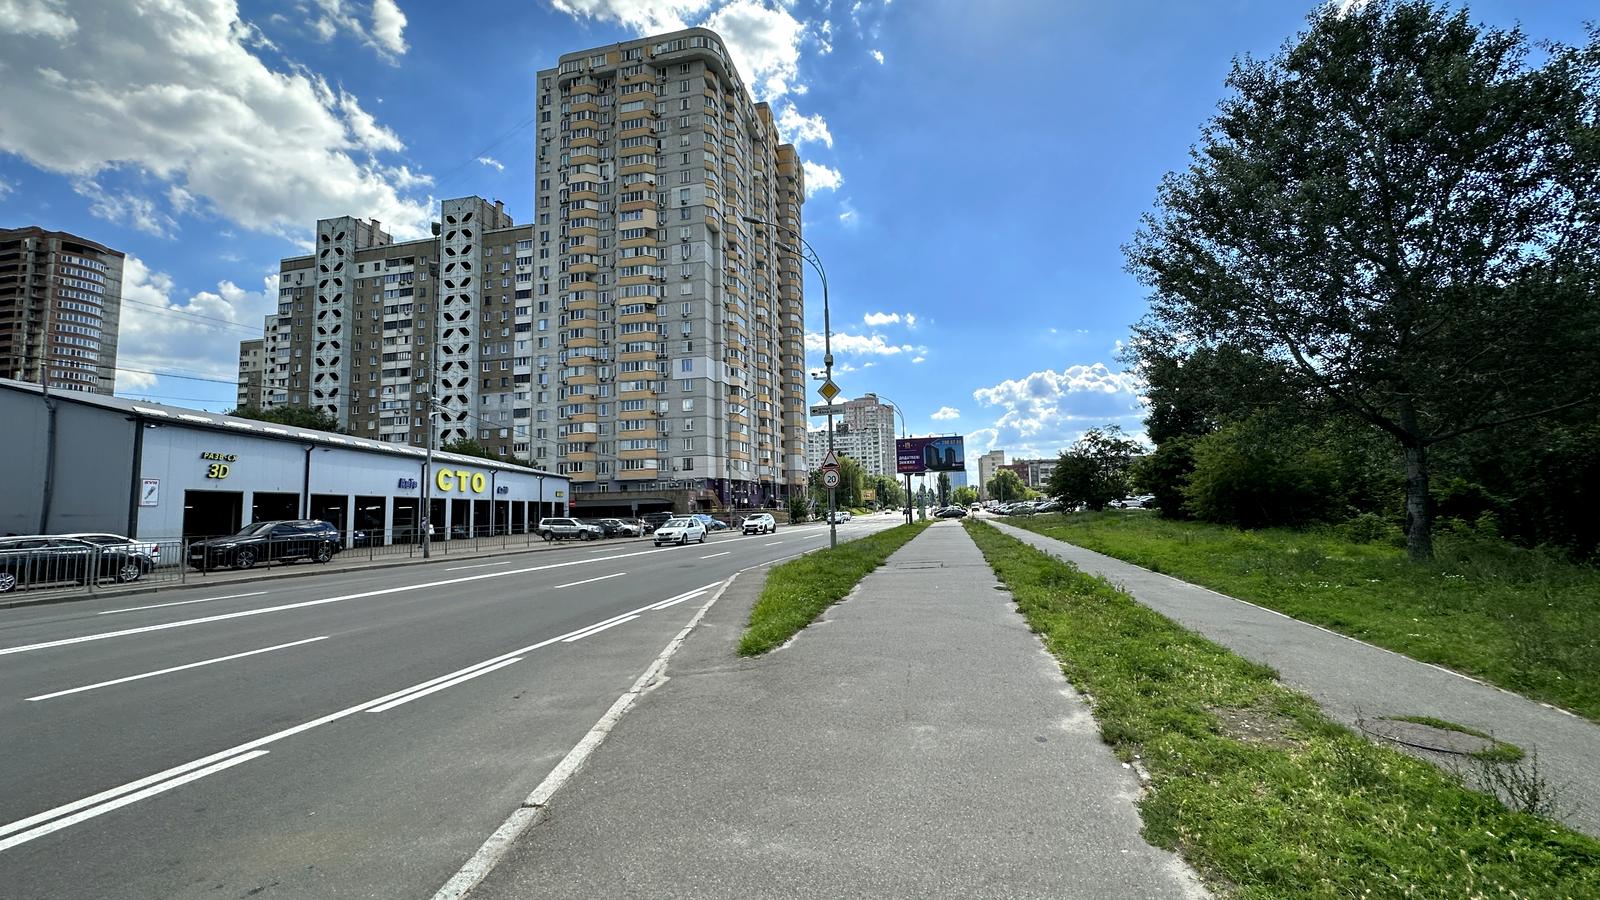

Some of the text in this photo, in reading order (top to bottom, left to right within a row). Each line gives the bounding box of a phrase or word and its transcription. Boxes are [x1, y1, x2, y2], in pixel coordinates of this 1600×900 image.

[207, 464, 230, 479] 3D
[437, 468, 486, 493] СТО
[827, 475, 837, 484] 20
